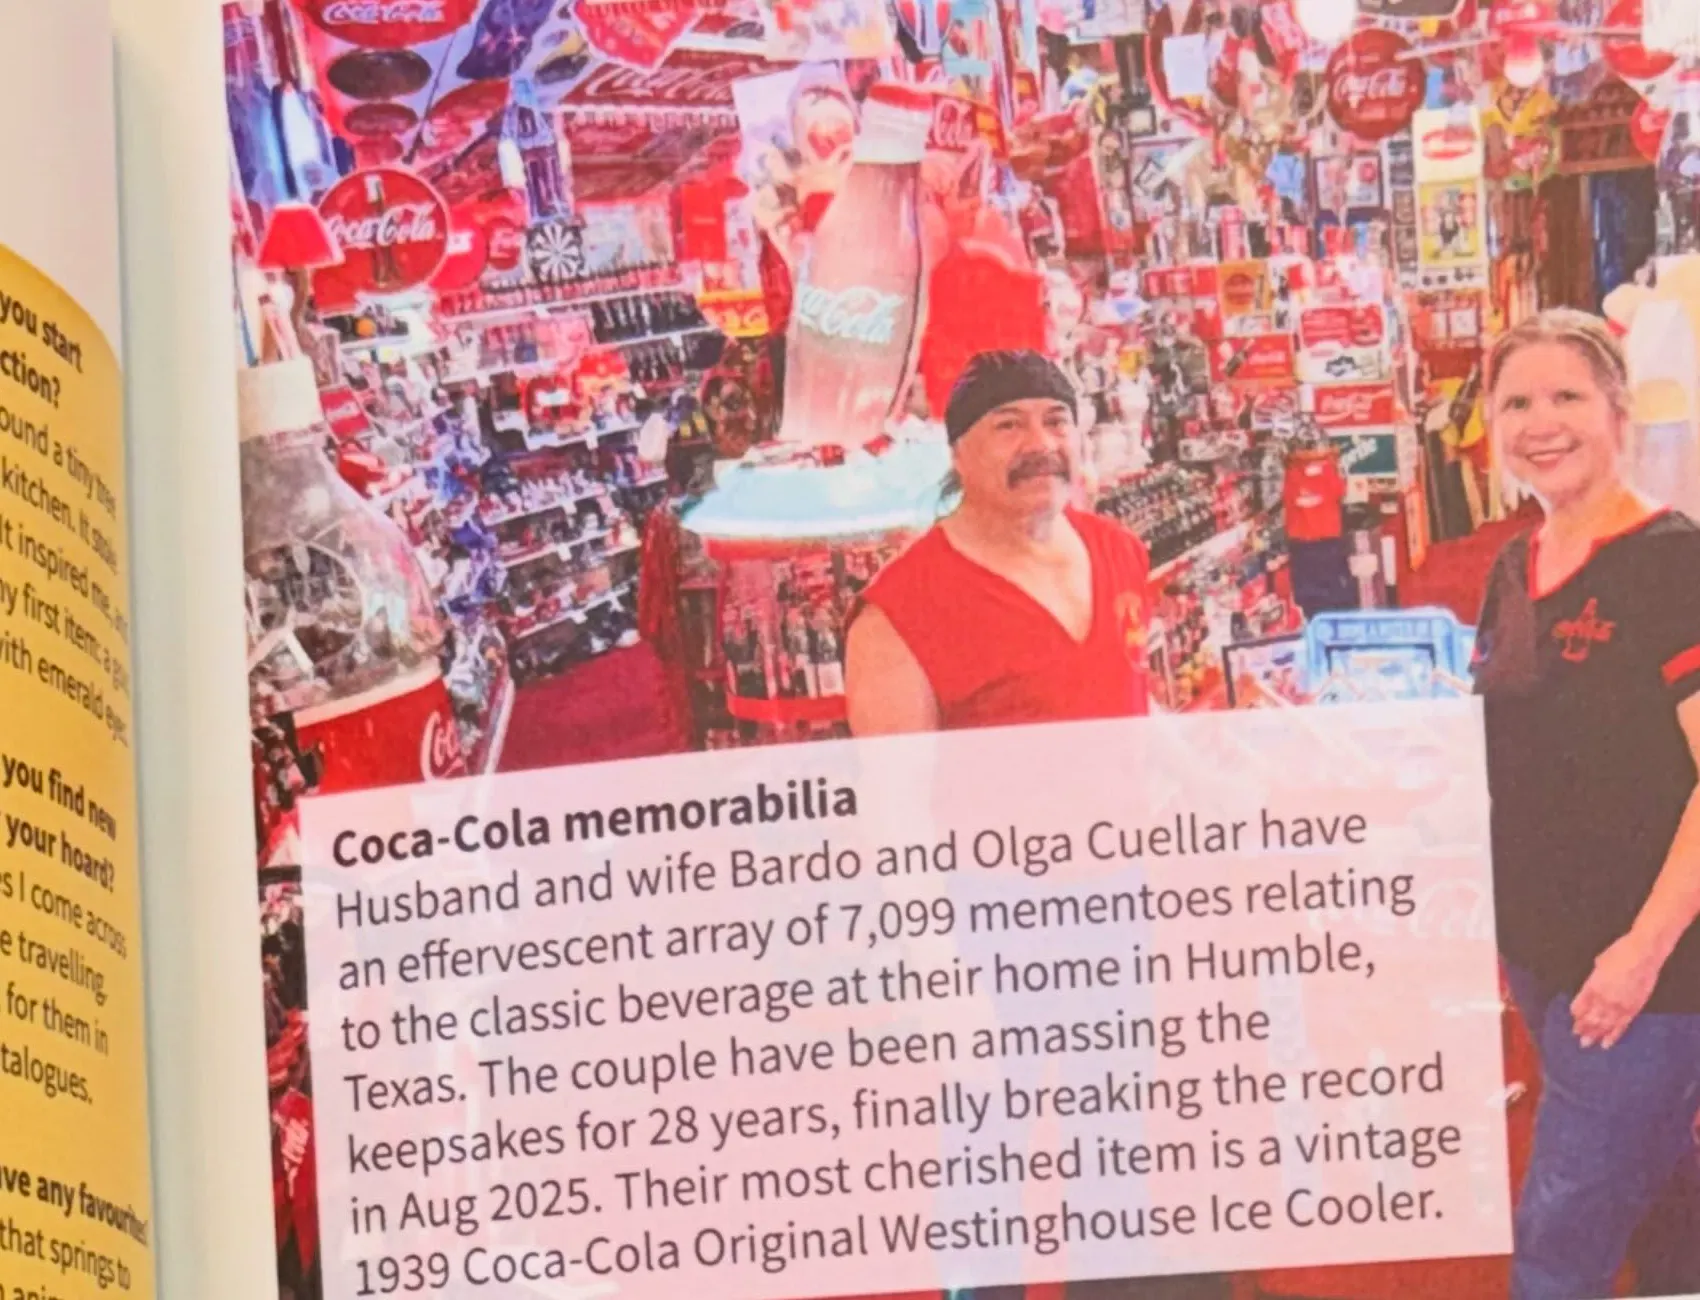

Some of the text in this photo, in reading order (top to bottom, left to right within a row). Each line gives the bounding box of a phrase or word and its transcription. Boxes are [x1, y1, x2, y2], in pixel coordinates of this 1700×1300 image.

[0, 291, 83, 373] you start
[2, 455, 76, 532] kitchen.
[53, 440, 63, 467] a
[18, 523, 88, 598] inspired
[23, 581, 61, 636] first
[38, 657, 103, 720] emerald
[2, 752, 116, 842] you find new
[332, 777, 857, 868] Coca-Cola memorabilia
[6, 813, 115, 894] your hoard?
[337, 808, 1366, 929] Husband and wife Bardo and Olga Cuellar have
[20, 871, 25, 902] I
[31, 883, 83, 930] come
[339, 868, 1415, 990] an effervescent array of 7,099 mementoes relating
[6, 982, 109, 1057] for them in
[341, 931, 1374, 1051] to the classic beverage at their home in Humble,
[0, 1045, 93, 1105] talogues.
[343, 1001, 1270, 1112] Texas. The couple have been amassing the
[348, 1119, 565, 1177] keepsakes
[576, 1110, 636, 1151] for
[649, 1106, 699, 1145] 28
[710, 1104, 840, 1152] years,
[852, 1082, 991, 1133] finally
[1004, 1071, 1203, 1120] breaking
[1213, 1064, 1286, 1105] the
[1302, 1051, 1443, 1100] record
[0, 1164, 31, 1198] ve
[36, 1176, 75, 1218] any
[351, 1122, 1461, 1236] in Aug 2025. Their most cherished item is a vintage
[0, 1217, 131, 1291] that springs to
[356, 1181, 1442, 1297] 1939 Coca-Cola Original Westinghouse Ice Cooler.
